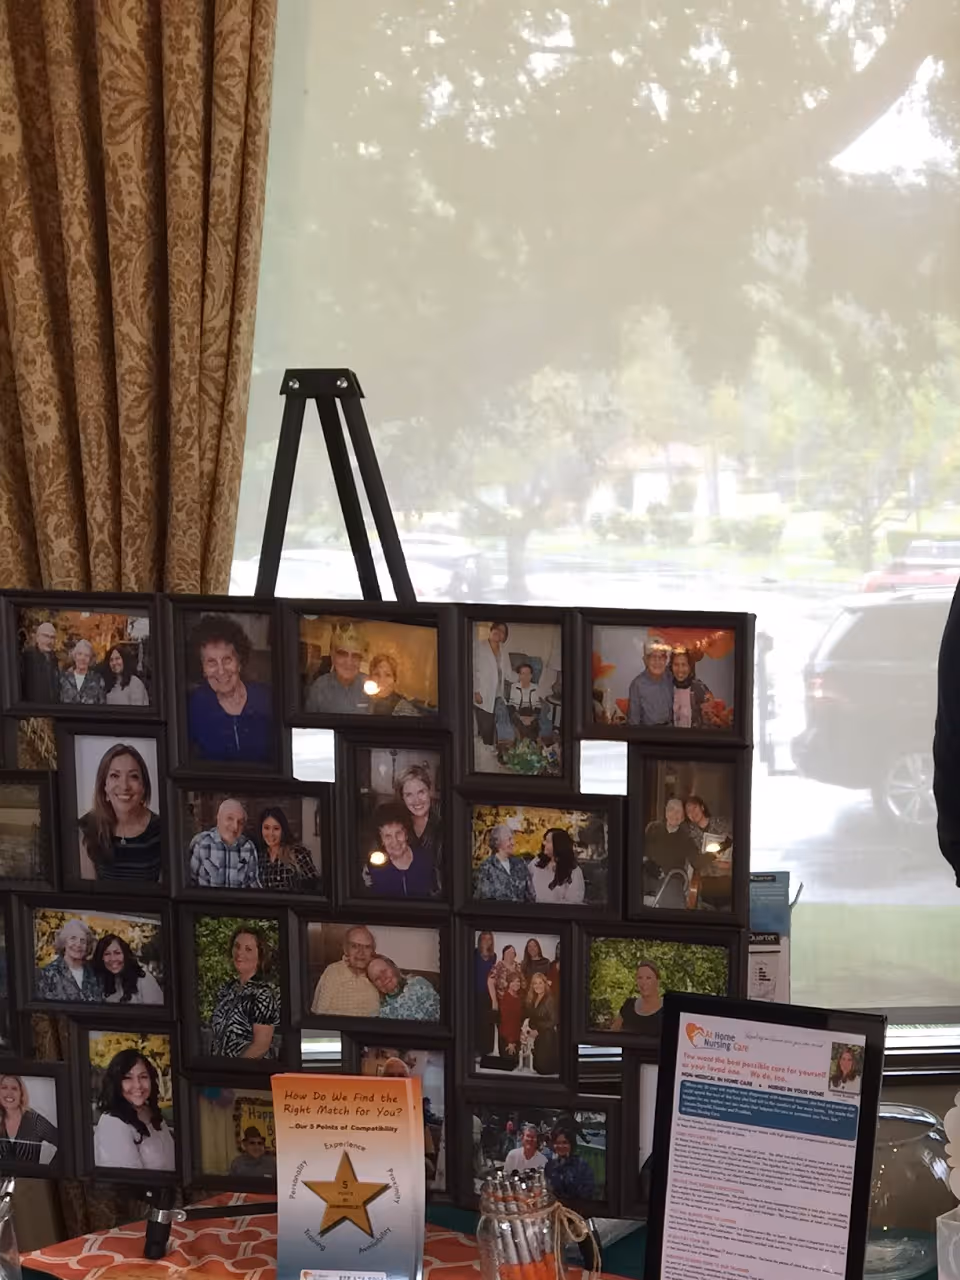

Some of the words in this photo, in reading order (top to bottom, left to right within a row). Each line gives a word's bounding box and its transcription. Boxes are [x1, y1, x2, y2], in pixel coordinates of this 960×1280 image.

[705, 1031, 714, 1039] At
[714, 1032, 736, 1042] Home
[704, 1038, 731, 1051] Nursing
[733, 1042, 749, 1052] Care
[285, 1090, 307, 1100] How
[313, 1091, 326, 1101] Do
[332, 1092, 347, 1101] We
[353, 1093, 375, 1103] Find
[380, 1093, 398, 1103] the
[284, 1104, 311, 1117] Right
[317, 1105, 349, 1115] Match
[356, 1106, 370, 1116] for
[377, 1107, 403, 1117] You?
[324, 1141, 366, 1152] Experience
[289, 1160, 308, 1200] Personality
[342, 1180, 349, 1189] 5
